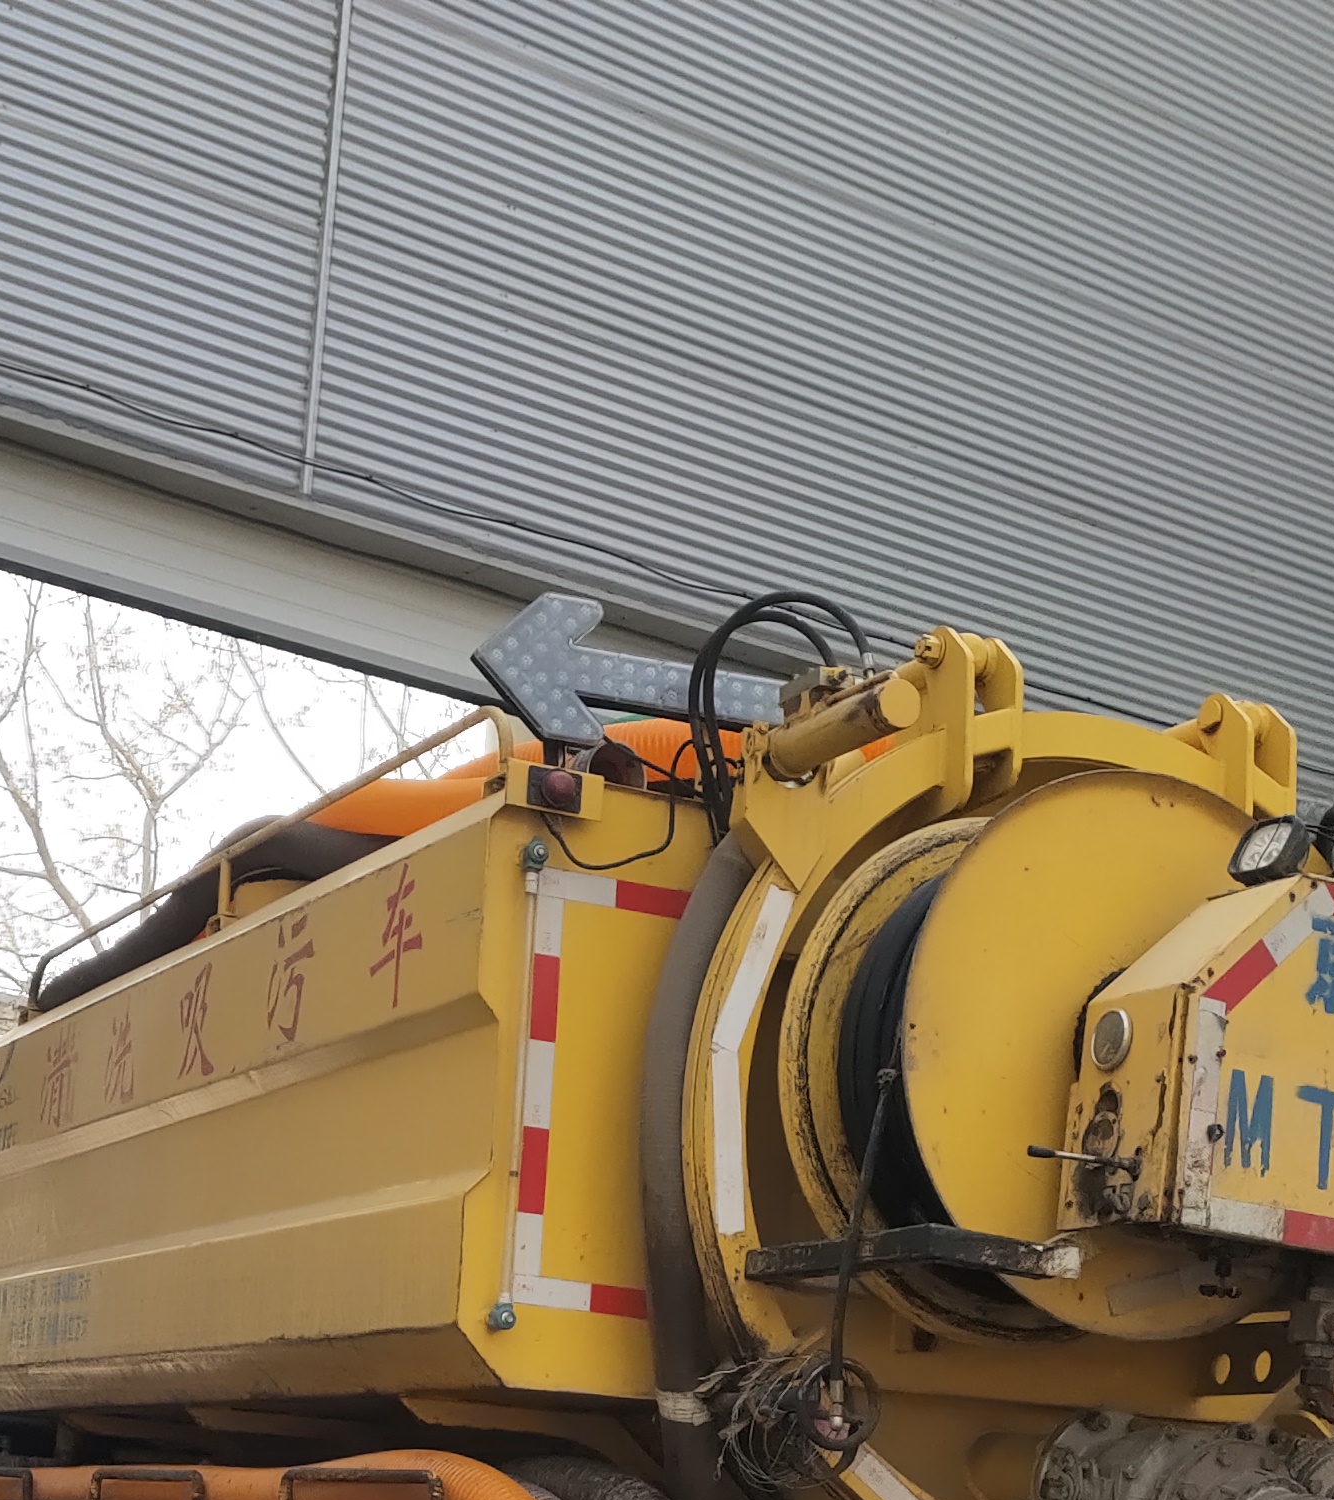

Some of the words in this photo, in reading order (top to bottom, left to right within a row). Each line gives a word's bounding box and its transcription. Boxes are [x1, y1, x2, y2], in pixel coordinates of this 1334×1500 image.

[39, 863, 424, 1128] 清洗吸污车
